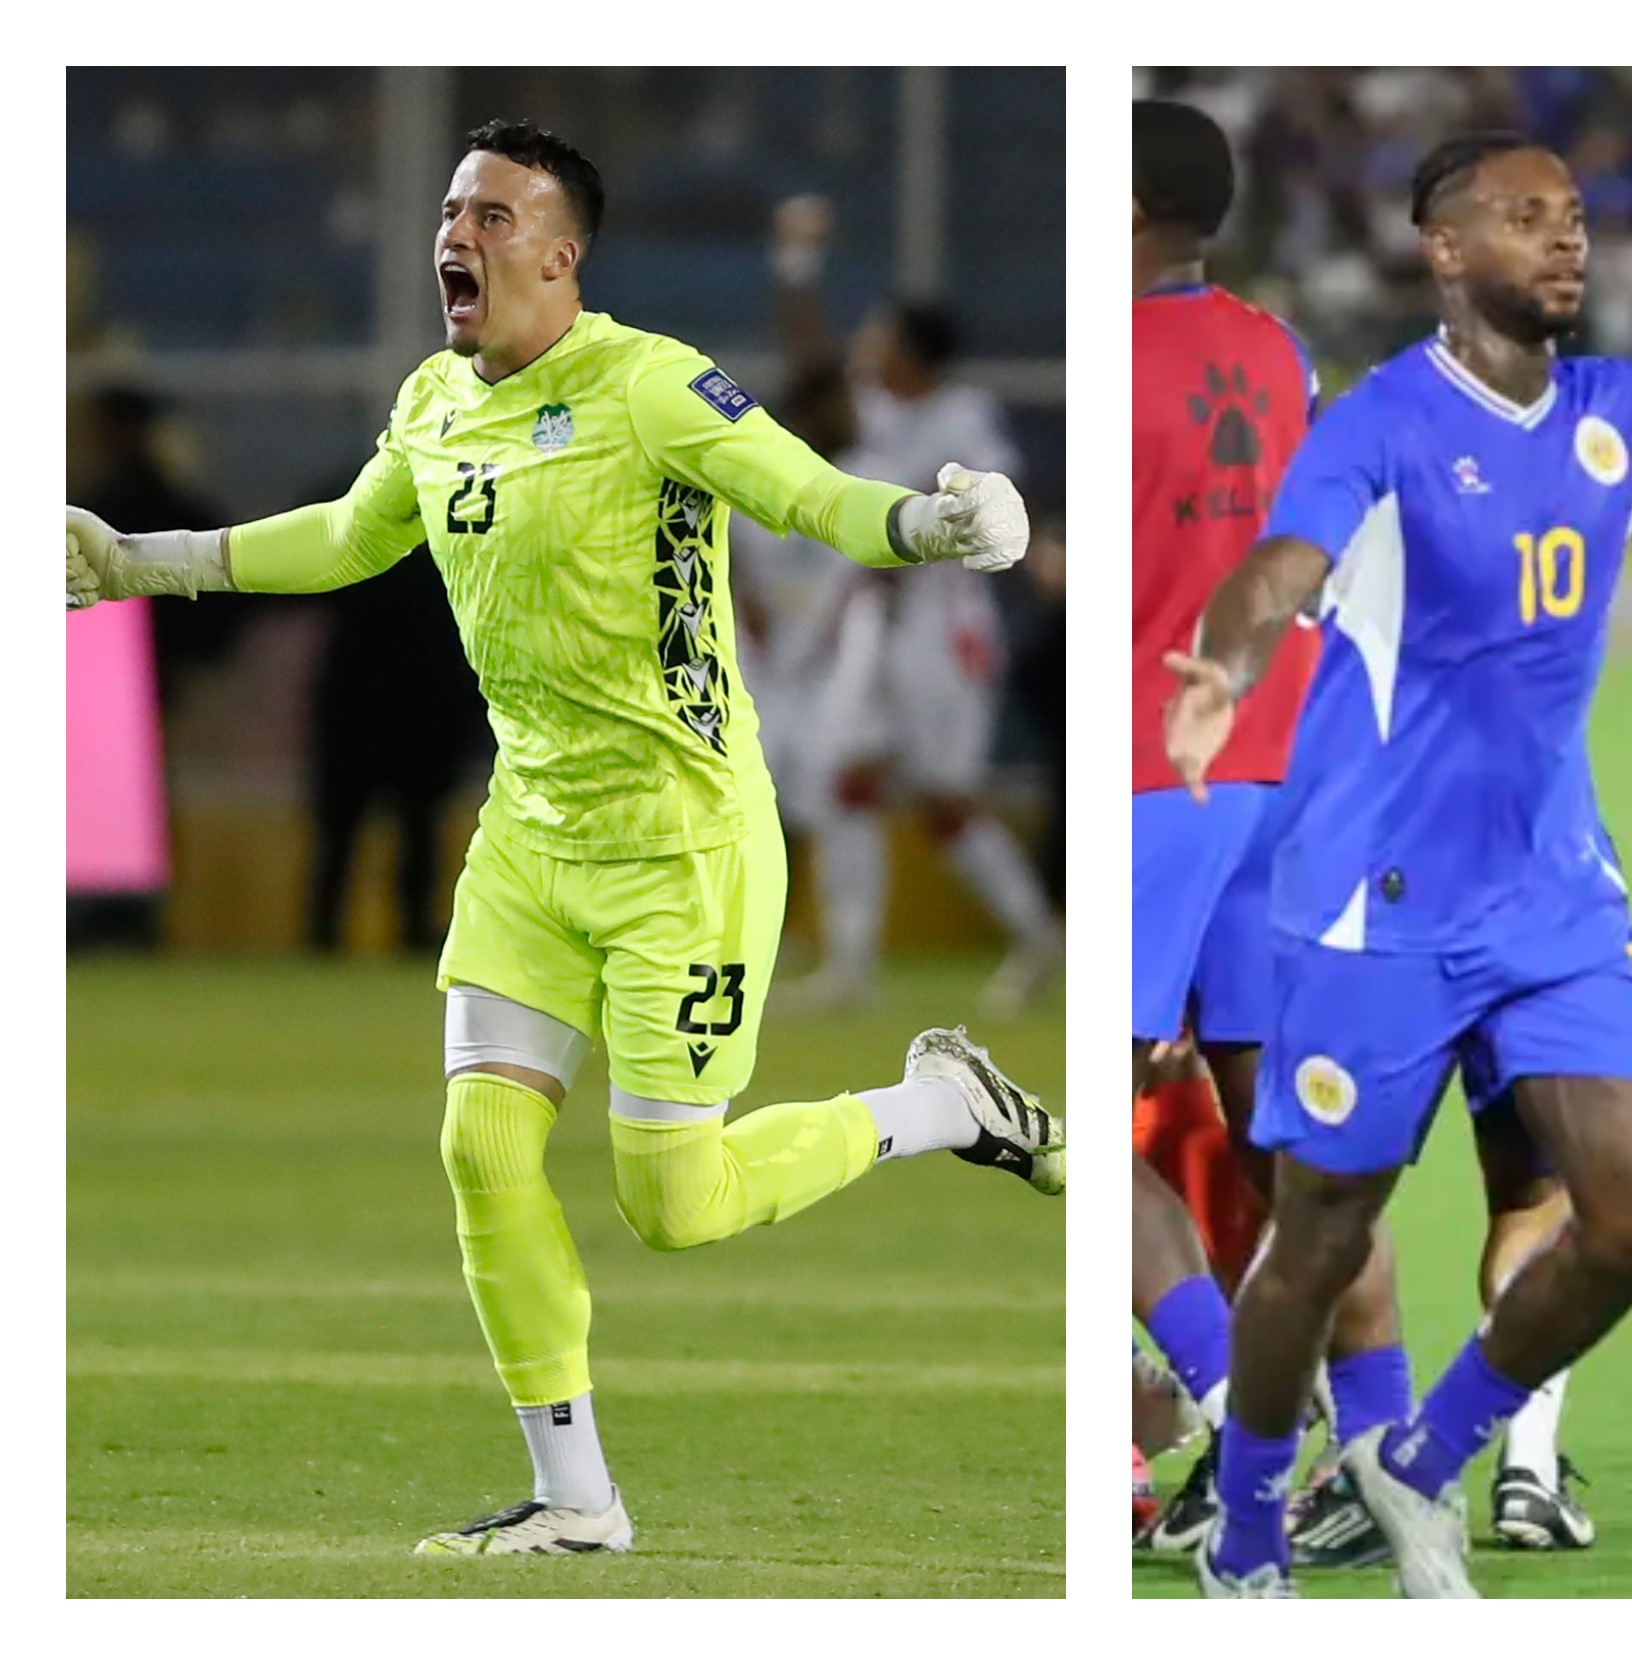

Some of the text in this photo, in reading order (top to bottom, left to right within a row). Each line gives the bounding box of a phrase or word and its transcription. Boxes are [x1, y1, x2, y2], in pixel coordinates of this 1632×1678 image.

[447, 461, 501, 534] 23
[1171, 490, 1273, 528] KEL
[1514, 527, 1584, 626] 10
[675, 963, 745, 1036] 23
